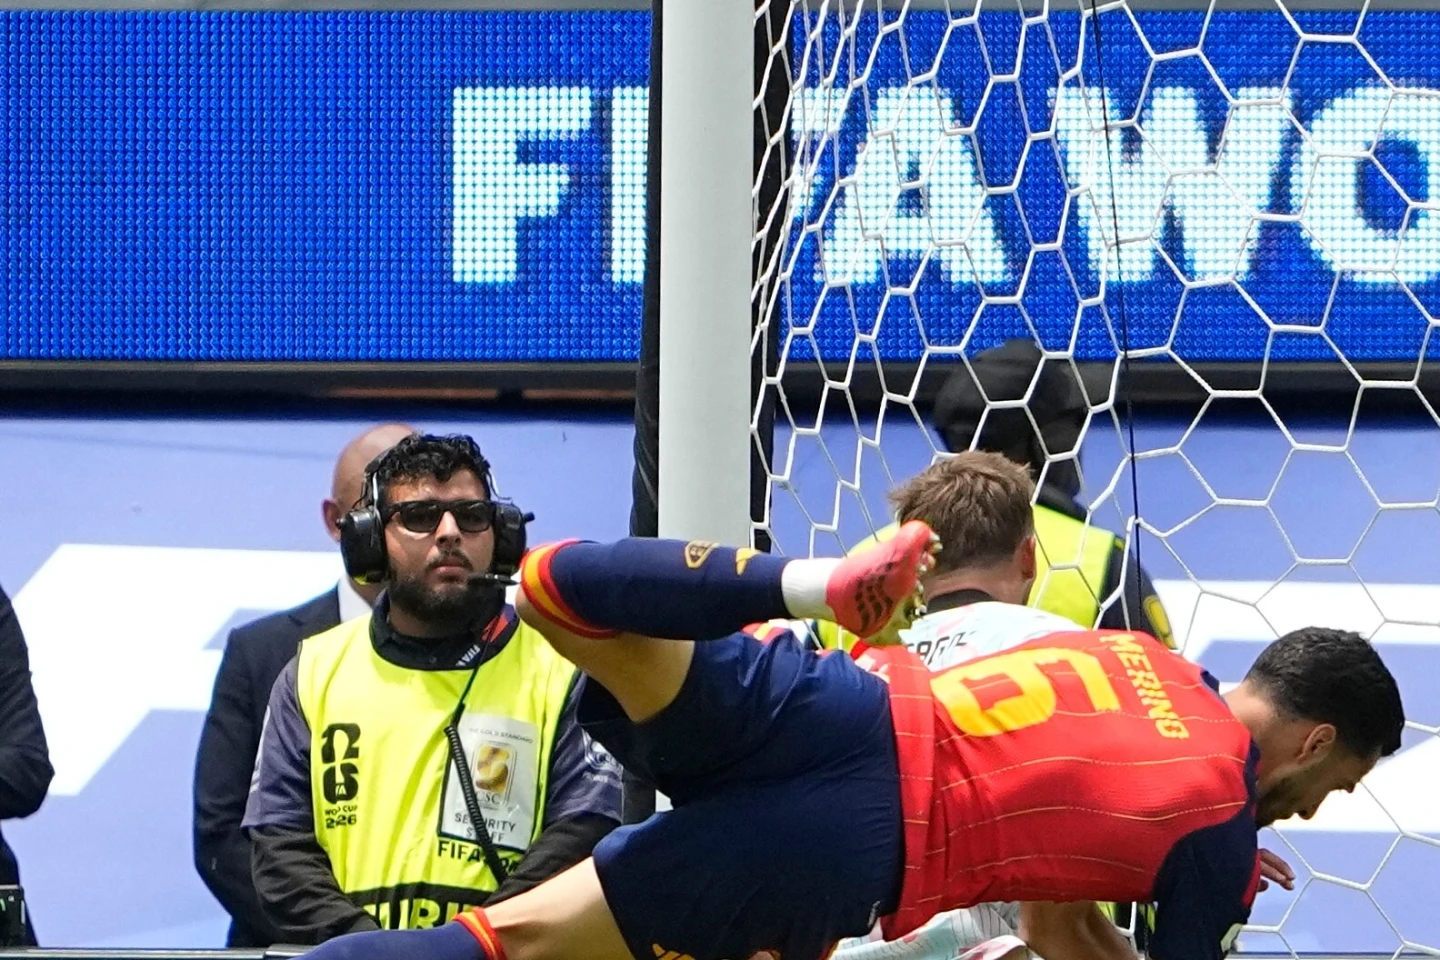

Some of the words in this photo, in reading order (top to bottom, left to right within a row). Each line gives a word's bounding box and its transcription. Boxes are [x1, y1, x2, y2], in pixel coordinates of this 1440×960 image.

[930, 646, 1122, 738] 6
[1101, 632, 1190, 740] MERINO
[454, 812, 516, 832] SERITY
